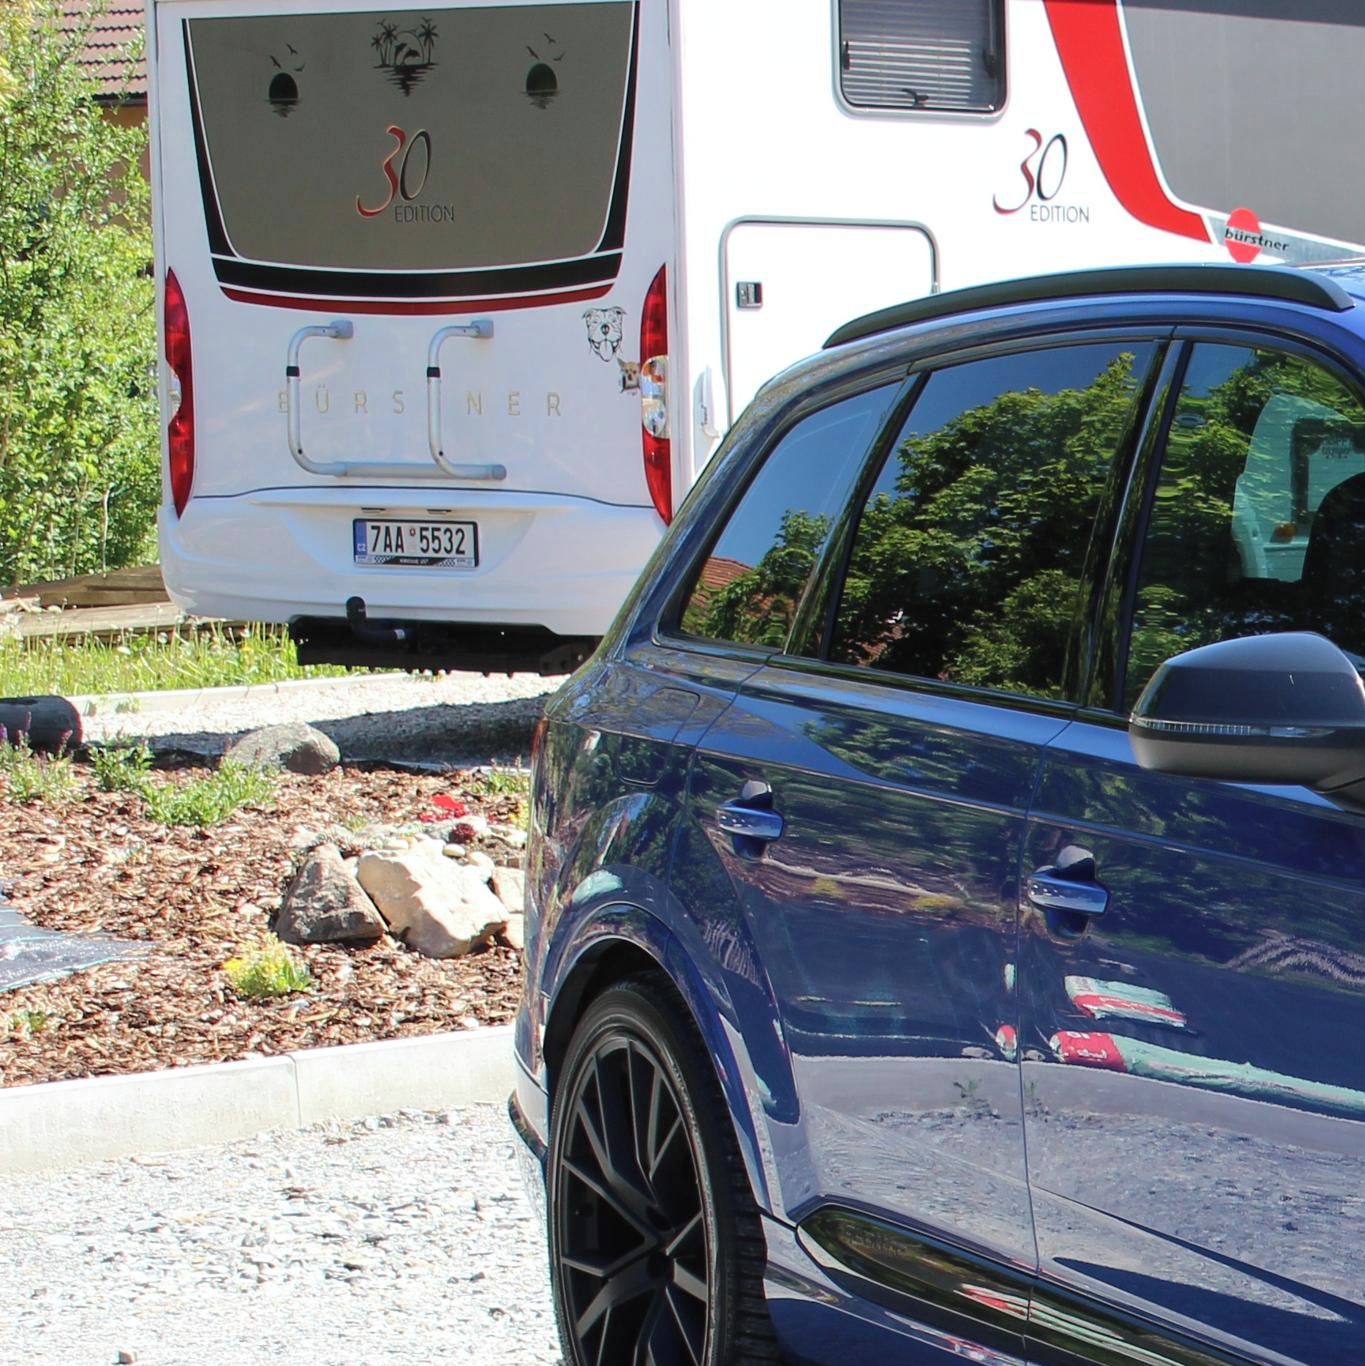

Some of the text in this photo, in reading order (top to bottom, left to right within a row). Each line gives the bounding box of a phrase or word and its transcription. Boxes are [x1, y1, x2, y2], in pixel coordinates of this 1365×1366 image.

[356, 125, 431, 218] 30
[992, 127, 1068, 215] 30
[394, 204, 455, 223] EDITION
[1030, 204, 1090, 223] EDITION
[1224, 227, 1290, 252] bürstner
[278, 384, 561, 417] BÜRSNER
[370, 525, 466, 555] 7AA 5532
